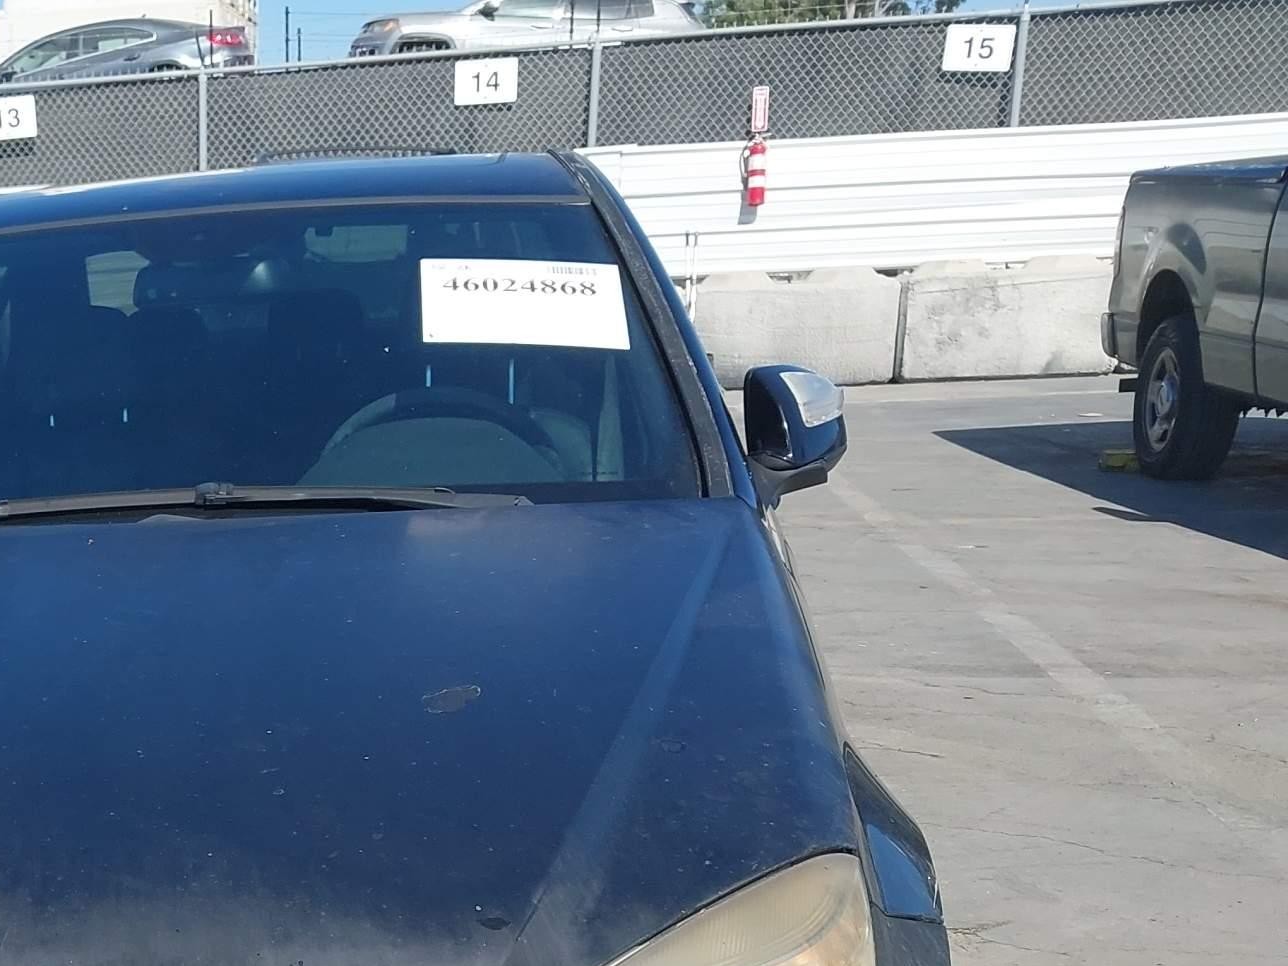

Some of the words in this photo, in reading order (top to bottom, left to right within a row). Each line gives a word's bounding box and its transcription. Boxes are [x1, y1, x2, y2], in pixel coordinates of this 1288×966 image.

[963, 36, 996, 60] 15
[471, 70, 500, 93] 14
[443, 277, 597, 296] 46024868
